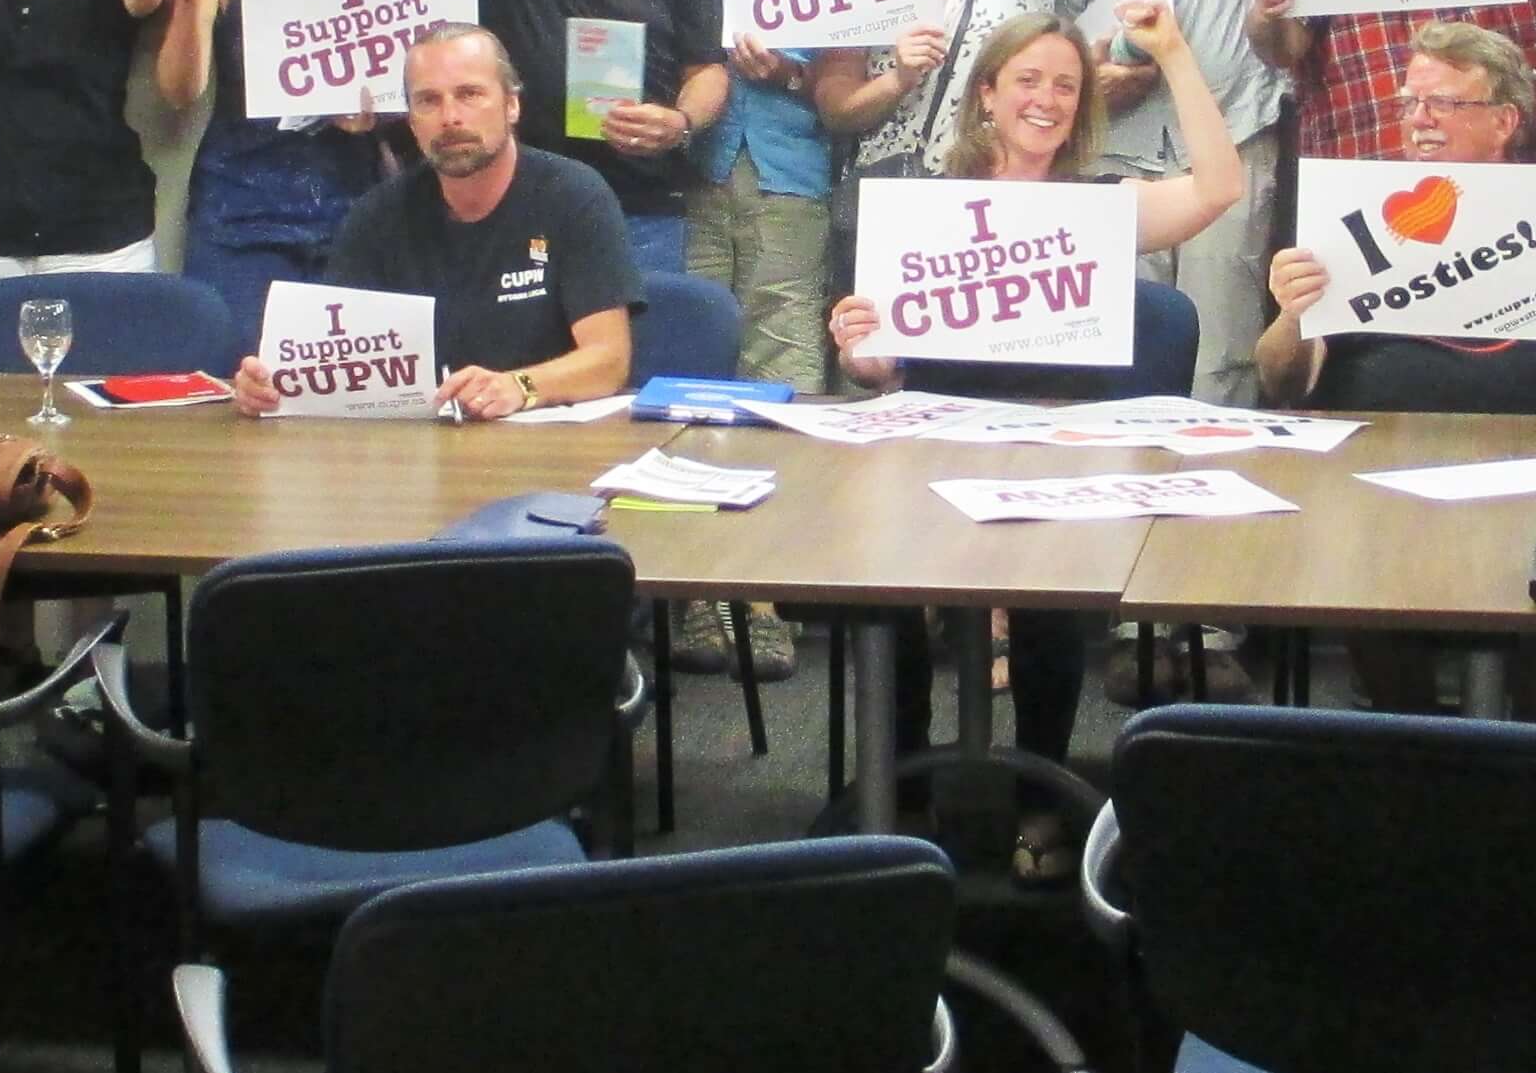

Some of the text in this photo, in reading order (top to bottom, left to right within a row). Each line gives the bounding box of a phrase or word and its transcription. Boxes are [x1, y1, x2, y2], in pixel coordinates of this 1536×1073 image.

[964, 198, 998, 243] I
[1340, 208, 1392, 276] I
[901, 227, 1076, 283] Support
[500, 268, 545, 289] CUPW
[891, 261, 1098, 337] CUPW
[325, 303, 346, 336] I
[988, 325, 1102, 354] www.cupw.ca
[280, 328, 402, 362] Support
[272, 354, 419, 397] CUPW
